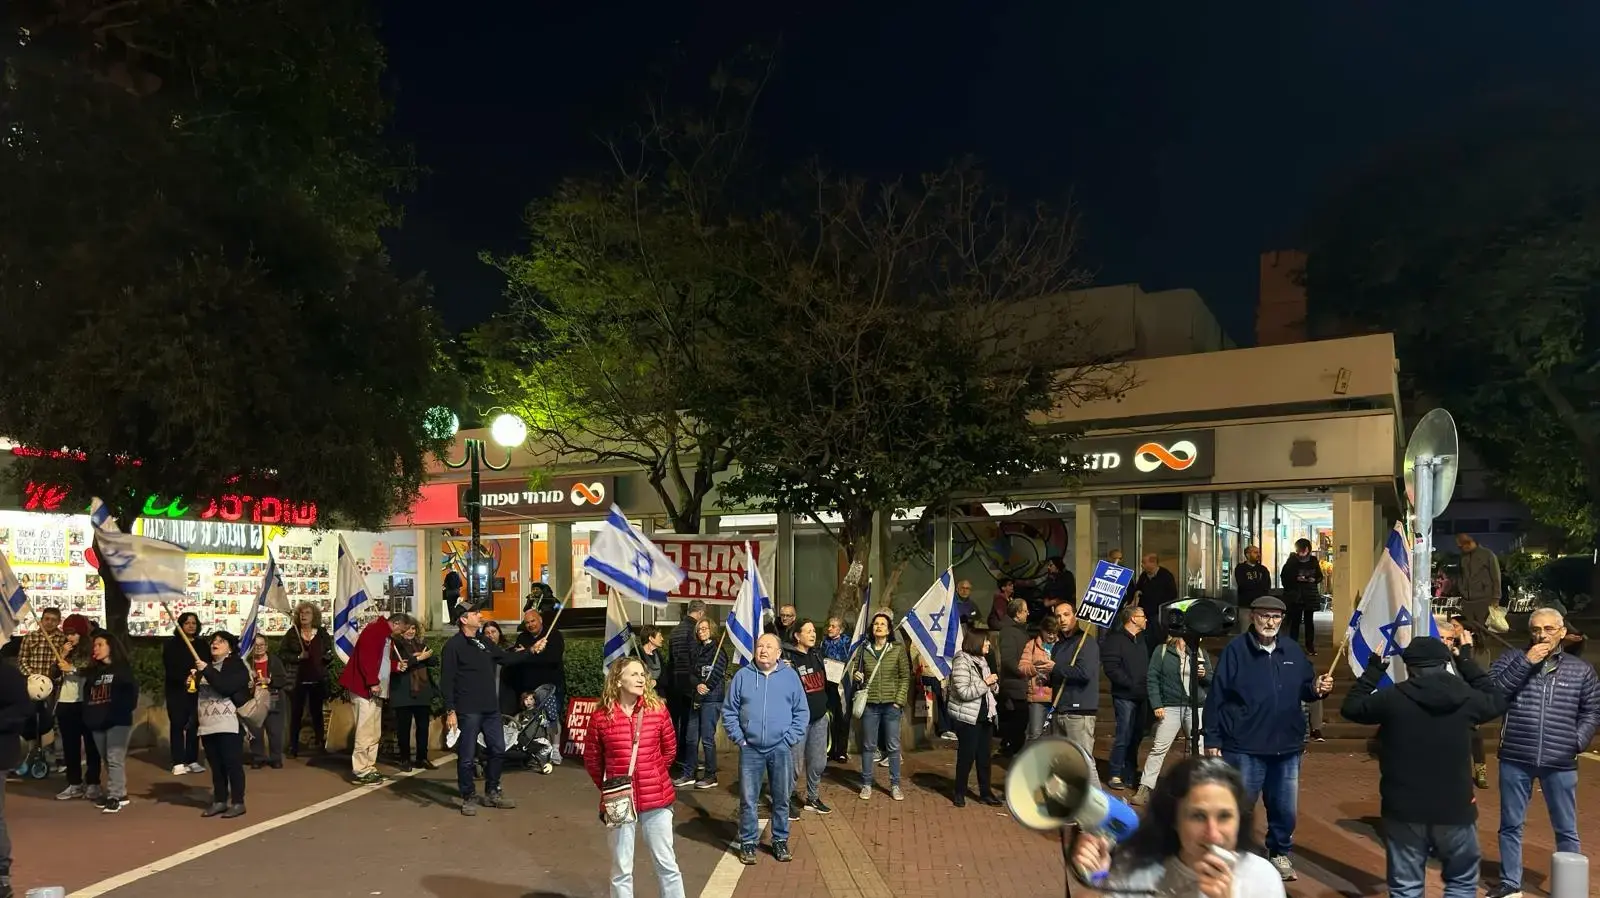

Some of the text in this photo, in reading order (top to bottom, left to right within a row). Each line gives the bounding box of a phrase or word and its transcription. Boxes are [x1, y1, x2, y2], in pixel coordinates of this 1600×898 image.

[481, 490, 564, 507] מזרחי טפחו
[690, 544, 749, 571] אתה
[1085, 590, 1119, 609] בחירות
[1079, 603, 1113, 624] עכשיו!
[569, 728, 587, 741] יבים
[564, 742, 585, 755] ירות
